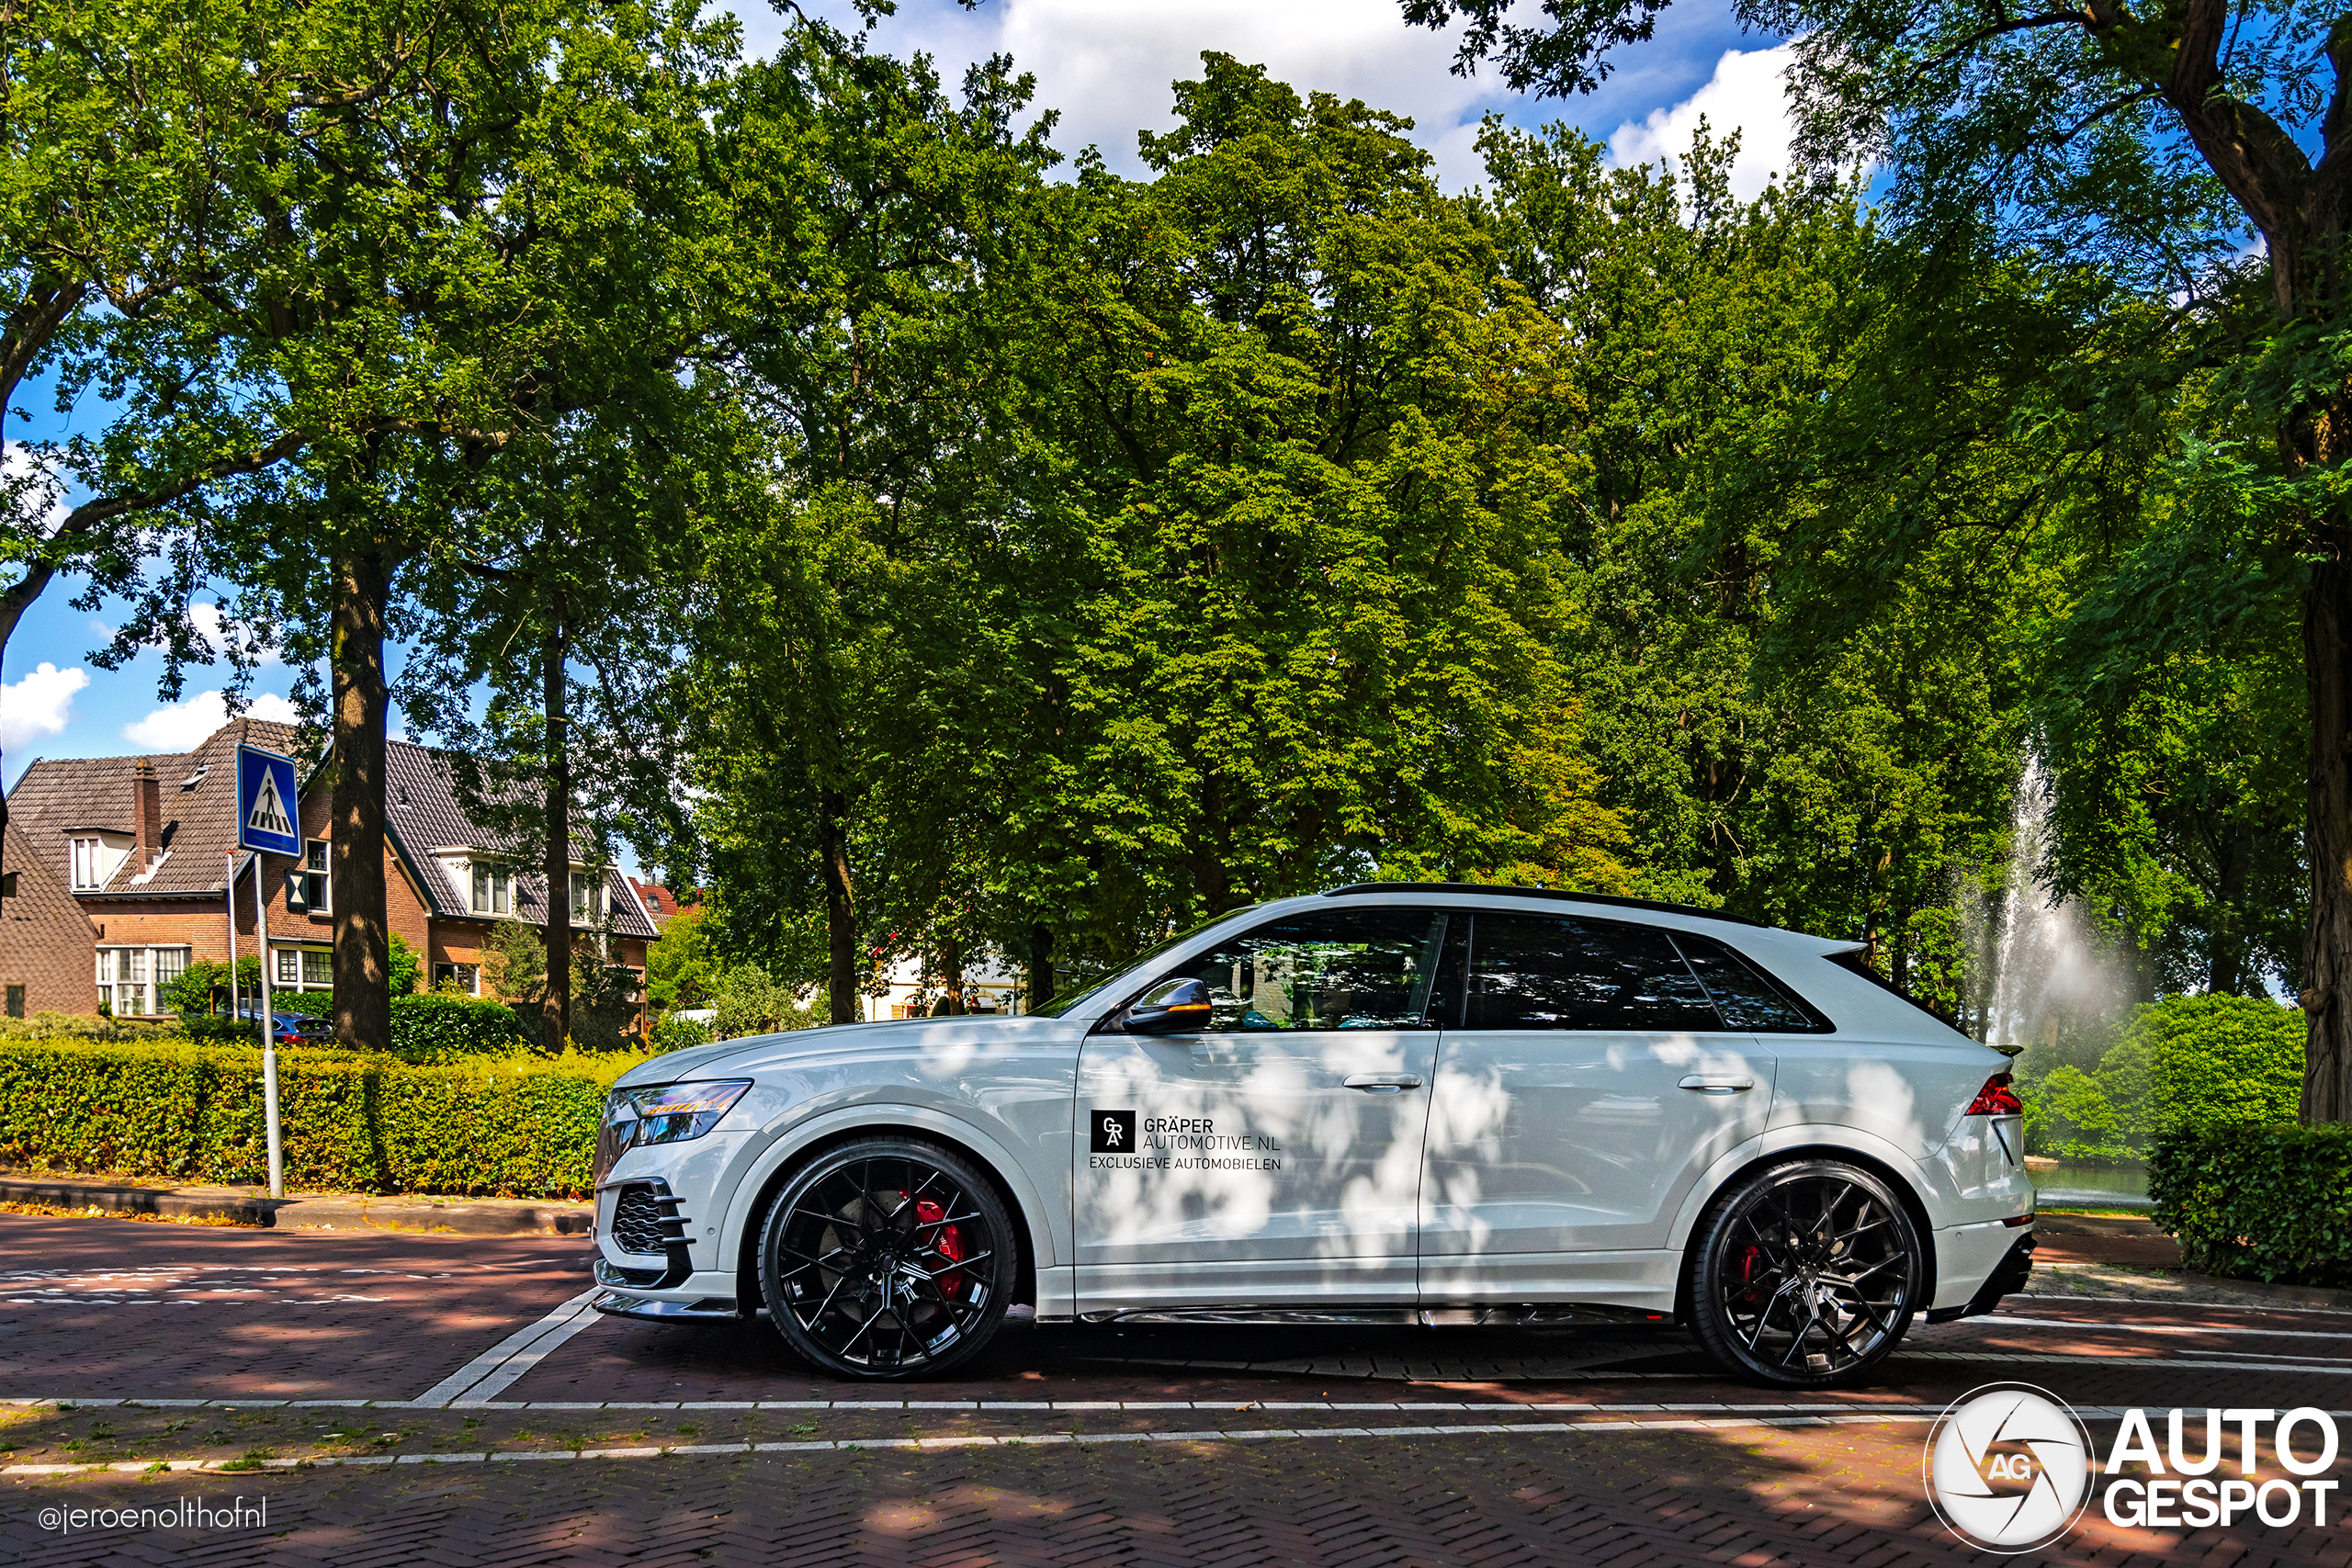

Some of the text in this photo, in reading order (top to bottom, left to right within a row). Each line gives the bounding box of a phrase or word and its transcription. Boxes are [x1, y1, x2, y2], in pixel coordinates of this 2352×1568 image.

[1144, 1115, 1214, 1134] GRÄPER
[1090, 1156, 1282, 1170] EXCLUSIEVE AUTOMOBIELEN
